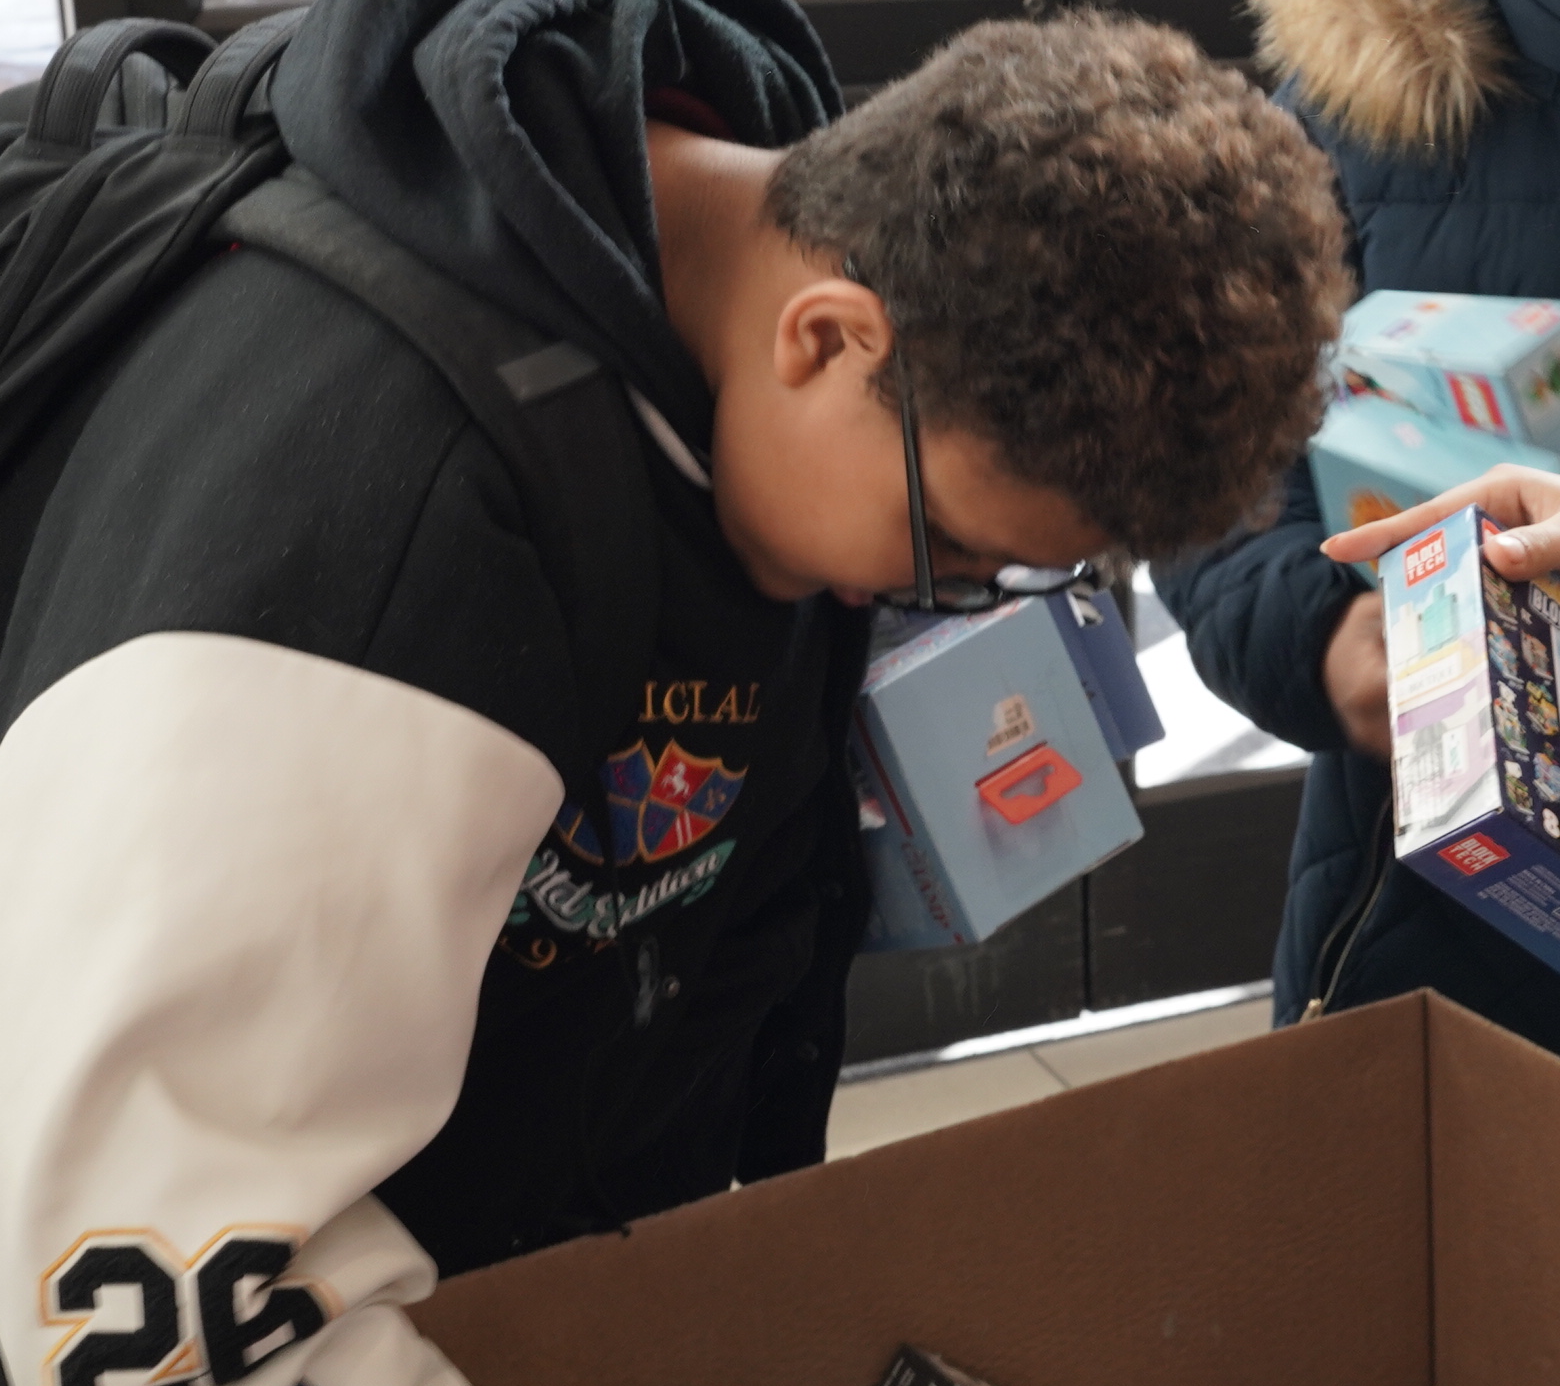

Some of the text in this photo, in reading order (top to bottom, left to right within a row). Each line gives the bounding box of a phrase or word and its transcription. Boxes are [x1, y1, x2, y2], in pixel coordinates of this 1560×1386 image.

[1406, 535, 1444, 570] BLOCK
[1407, 552, 1445, 582] TECH
[1451, 846, 1485, 871] TECH
[1462, 835, 1501, 864] BLOCK
